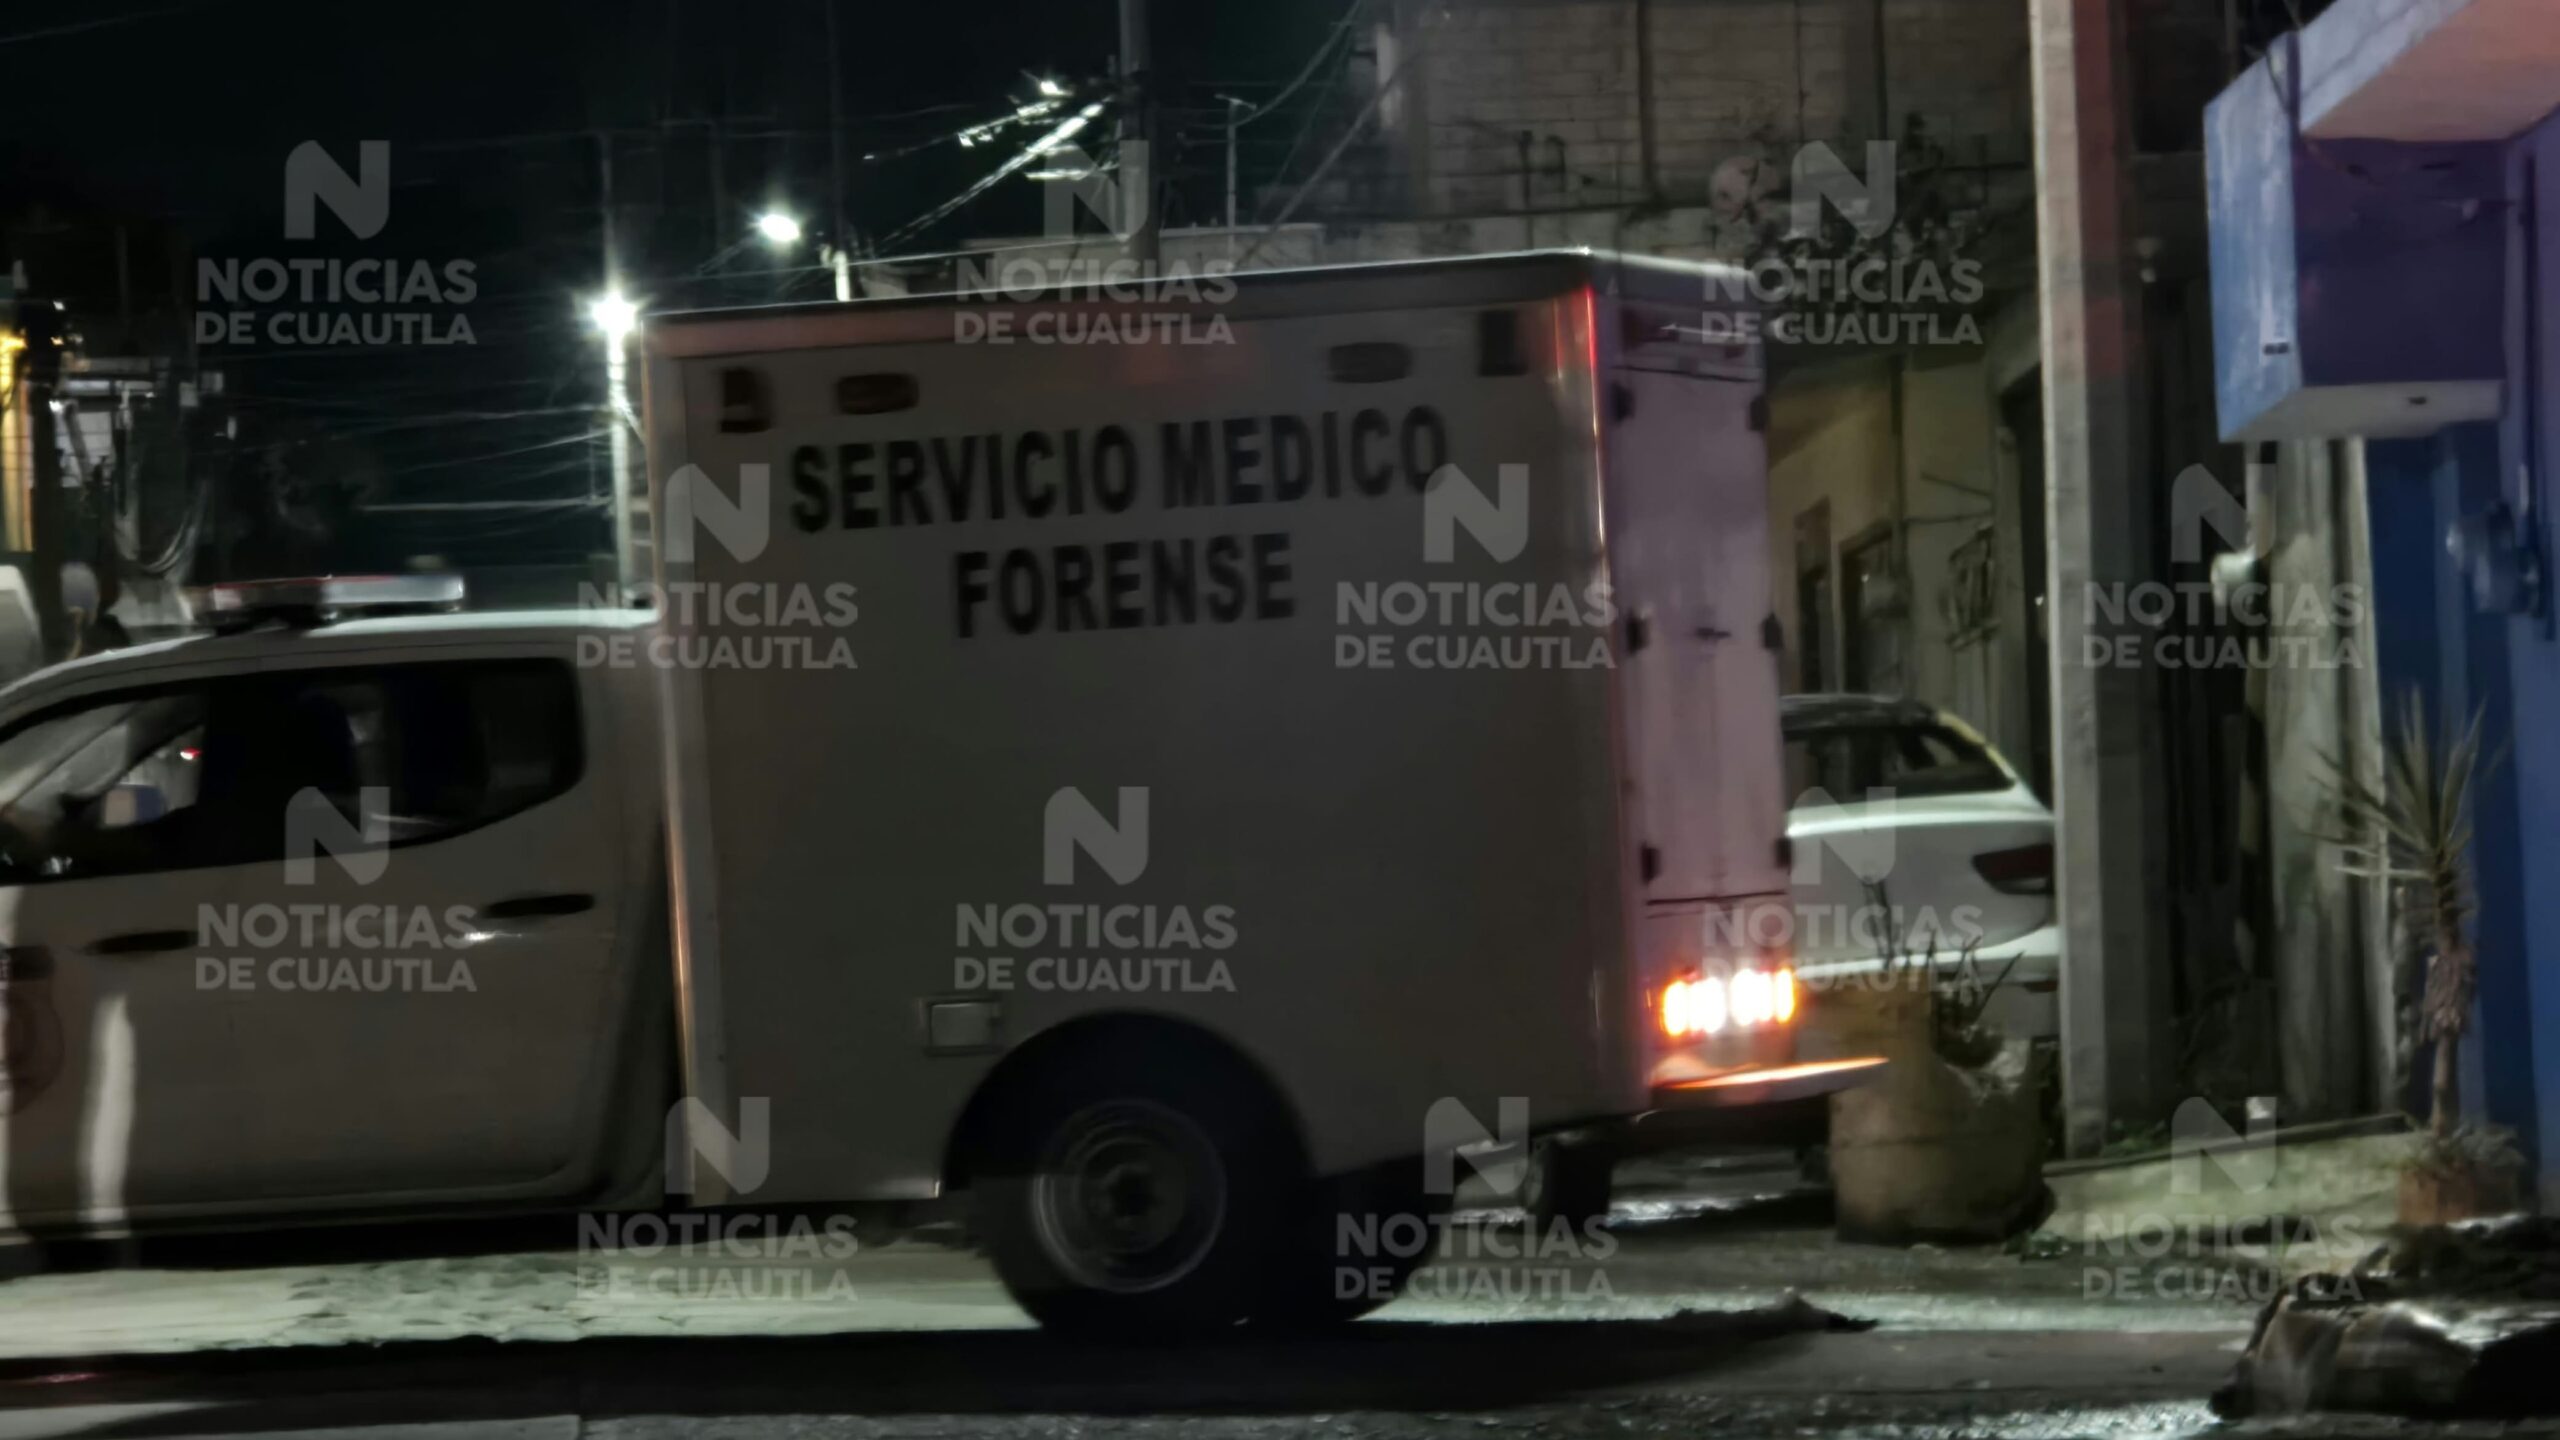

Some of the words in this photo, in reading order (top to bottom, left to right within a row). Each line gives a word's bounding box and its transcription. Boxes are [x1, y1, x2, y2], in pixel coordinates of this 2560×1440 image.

[791, 424, 1138, 532] SERVICIO
[1161, 405, 1447, 508] MEDICO
[955, 532, 1296, 638] FORENSE
